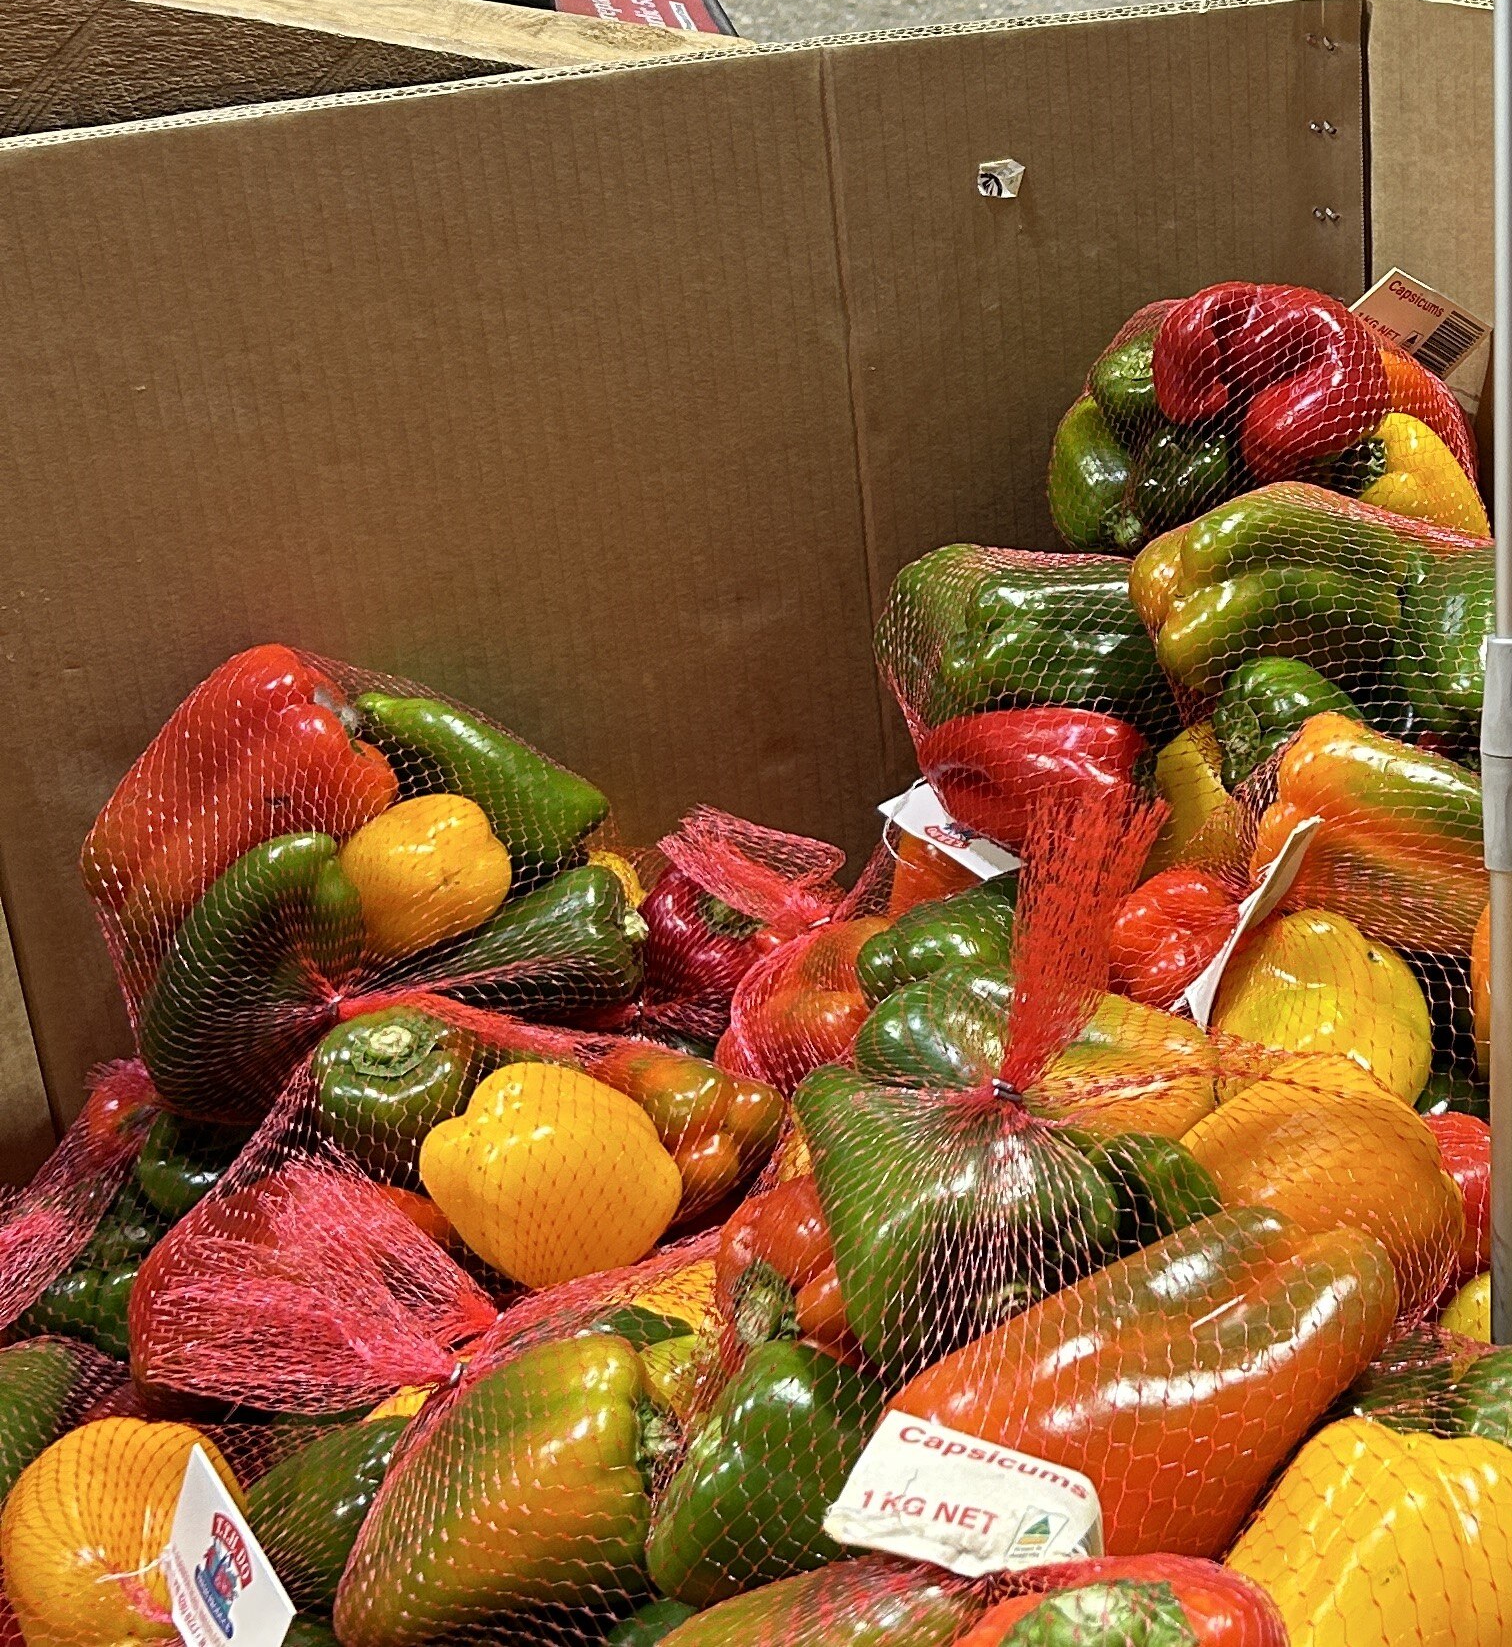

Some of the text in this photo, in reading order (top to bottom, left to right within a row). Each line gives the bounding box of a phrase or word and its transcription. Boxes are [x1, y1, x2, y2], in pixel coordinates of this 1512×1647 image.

[1388, 280, 1445, 318] Capsicums
[898, 1426, 1091, 1500] Capsicums
[862, 1489, 999, 1535] 1 KG NET
